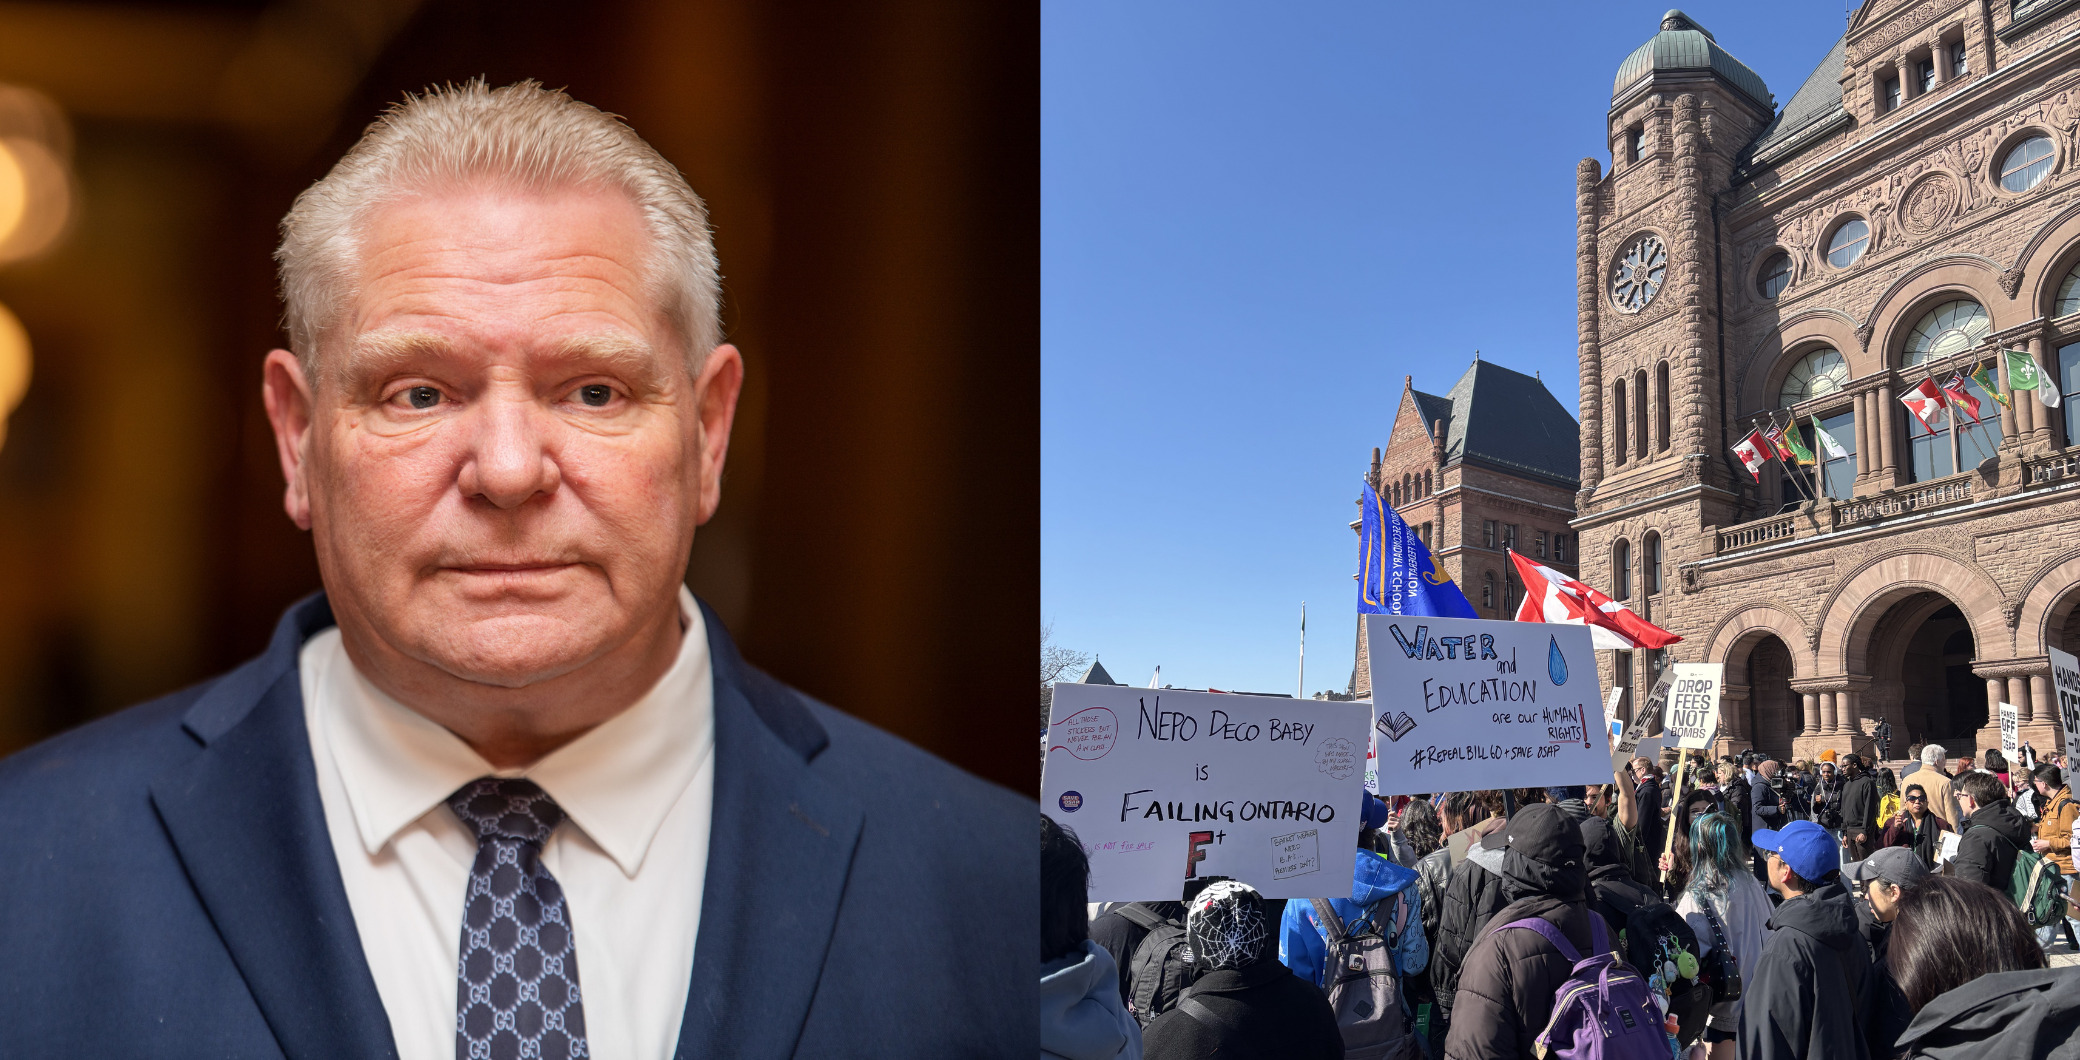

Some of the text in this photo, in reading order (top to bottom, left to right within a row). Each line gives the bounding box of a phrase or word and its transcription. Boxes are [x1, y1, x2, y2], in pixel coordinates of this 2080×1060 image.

[1389, 623, 1498, 661] WATER
[1496, 646, 1517, 675] and
[1423, 677, 1537, 713] EDUCATION
[1677, 679, 1713, 693] DROP
[1674, 693, 1711, 710] FEES
[1138, 695, 1315, 746] NEPO DECO BABY
[1492, 705, 1578, 725] are our HUMAN
[1672, 709, 1710, 728] NOT
[1670, 726, 1706, 739] BOMBS
[1466, 745, 1488, 762] BILL
[1490, 744, 1503, 760] 60
[1511, 745, 1534, 761] SAVE
[1121, 789, 1335, 823] FAILING ONTARIO
